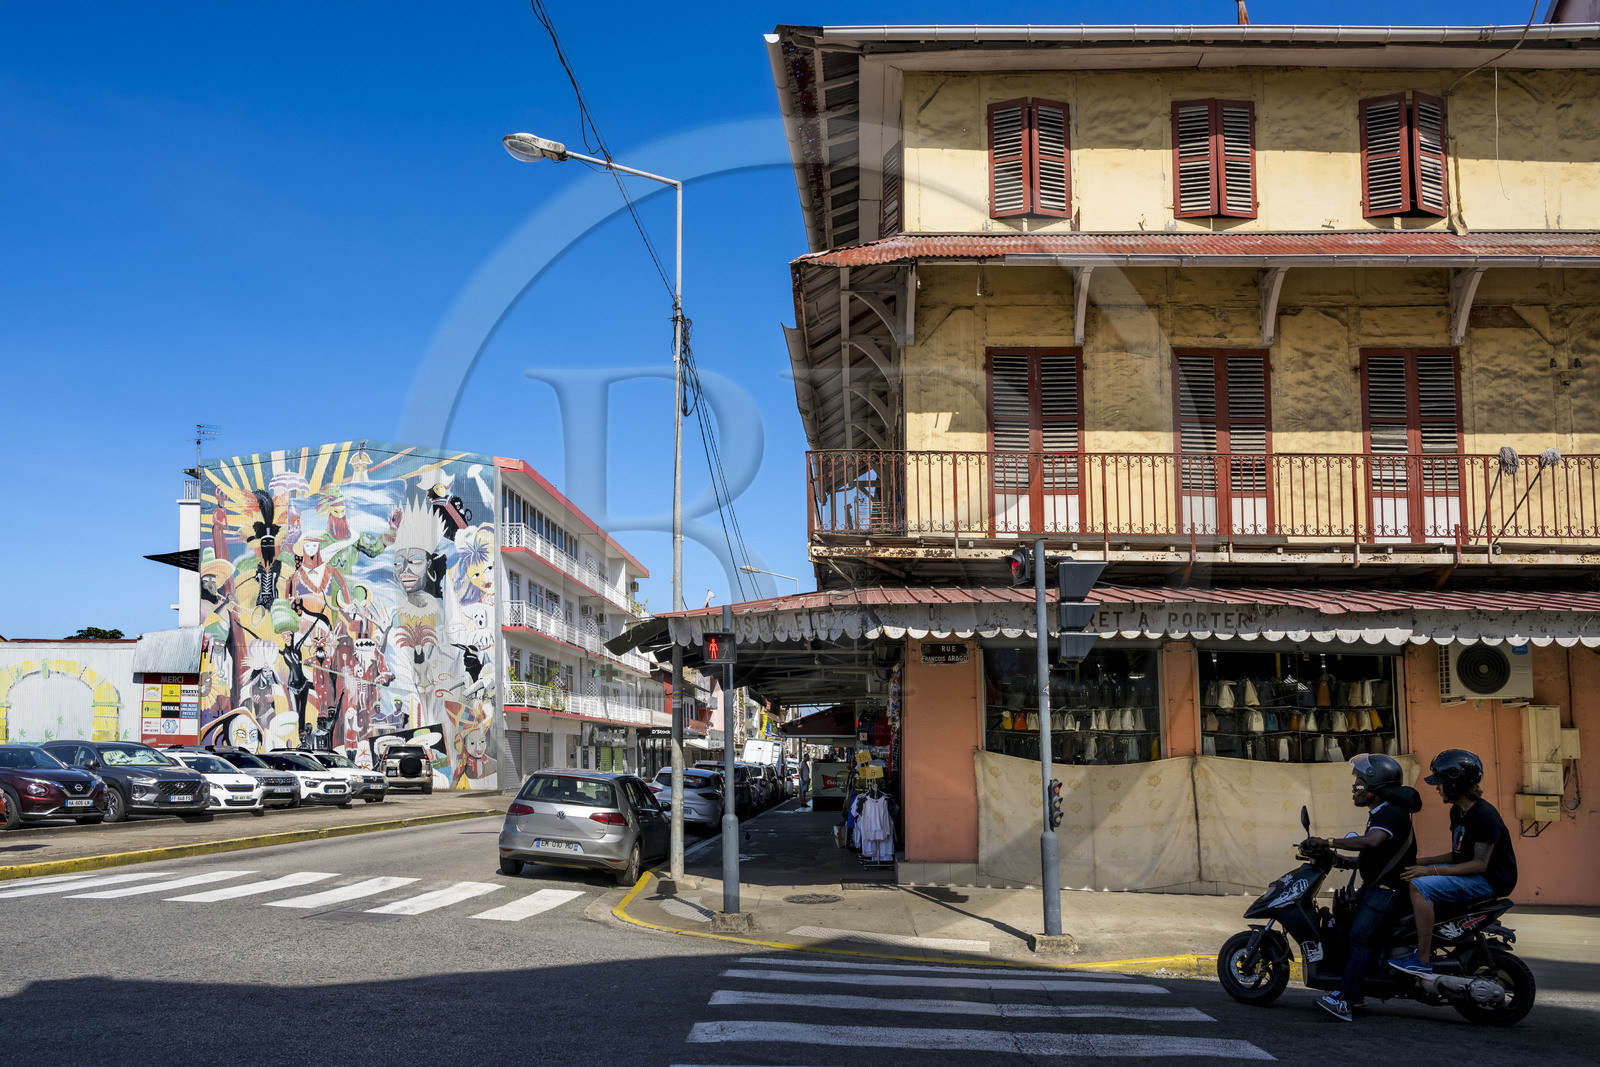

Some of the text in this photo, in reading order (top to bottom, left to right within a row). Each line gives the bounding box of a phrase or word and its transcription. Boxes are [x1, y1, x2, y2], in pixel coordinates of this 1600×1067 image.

[700, 615, 777, 634] MAASIN
[1168, 612, 1249, 628] PORTER
[161, 676, 184, 684] MERCI
